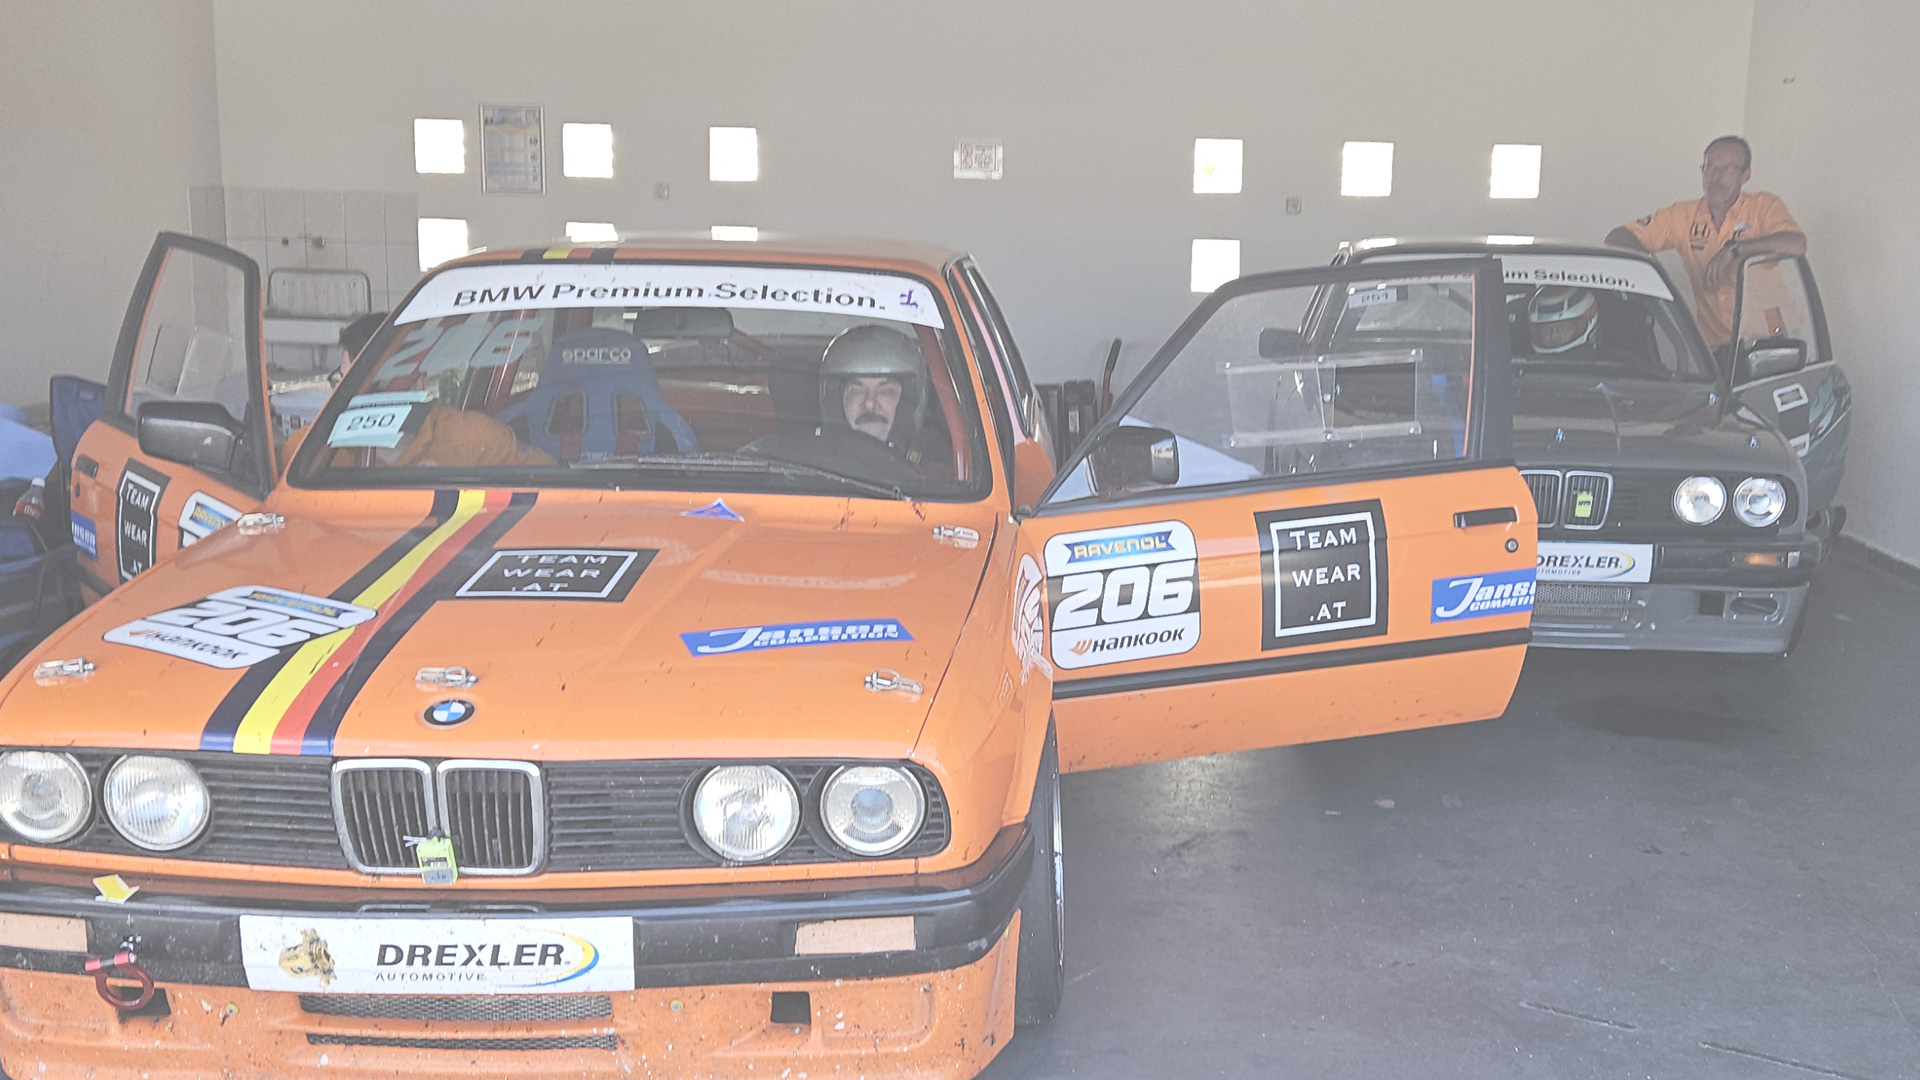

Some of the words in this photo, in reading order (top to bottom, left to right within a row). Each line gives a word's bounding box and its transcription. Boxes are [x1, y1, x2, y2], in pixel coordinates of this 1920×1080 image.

[1534, 269, 1636, 288] Selection.
[453, 284, 546, 307] BMW
[552, 281, 704, 299] Premium
[714, 282, 886, 310] Selection.
[562, 346, 632, 363] sparco
[346, 413, 396, 432] 250
[126, 482, 149, 512] TEAM
[123, 519, 147, 548] WEAR
[1289, 526, 1358, 551] TEAM
[517, 554, 608, 565] TEAM
[1073, 535, 1167, 560] RAVENOL
[503, 568, 601, 578] WEAR
[1291, 563, 1361, 588] WEAR
[1052, 559, 1196, 631] 206
[146, 599, 340, 648] 206
[1309, 600, 1347, 622] .AT
[375, 972, 486, 982] AUTOMOTIVE
